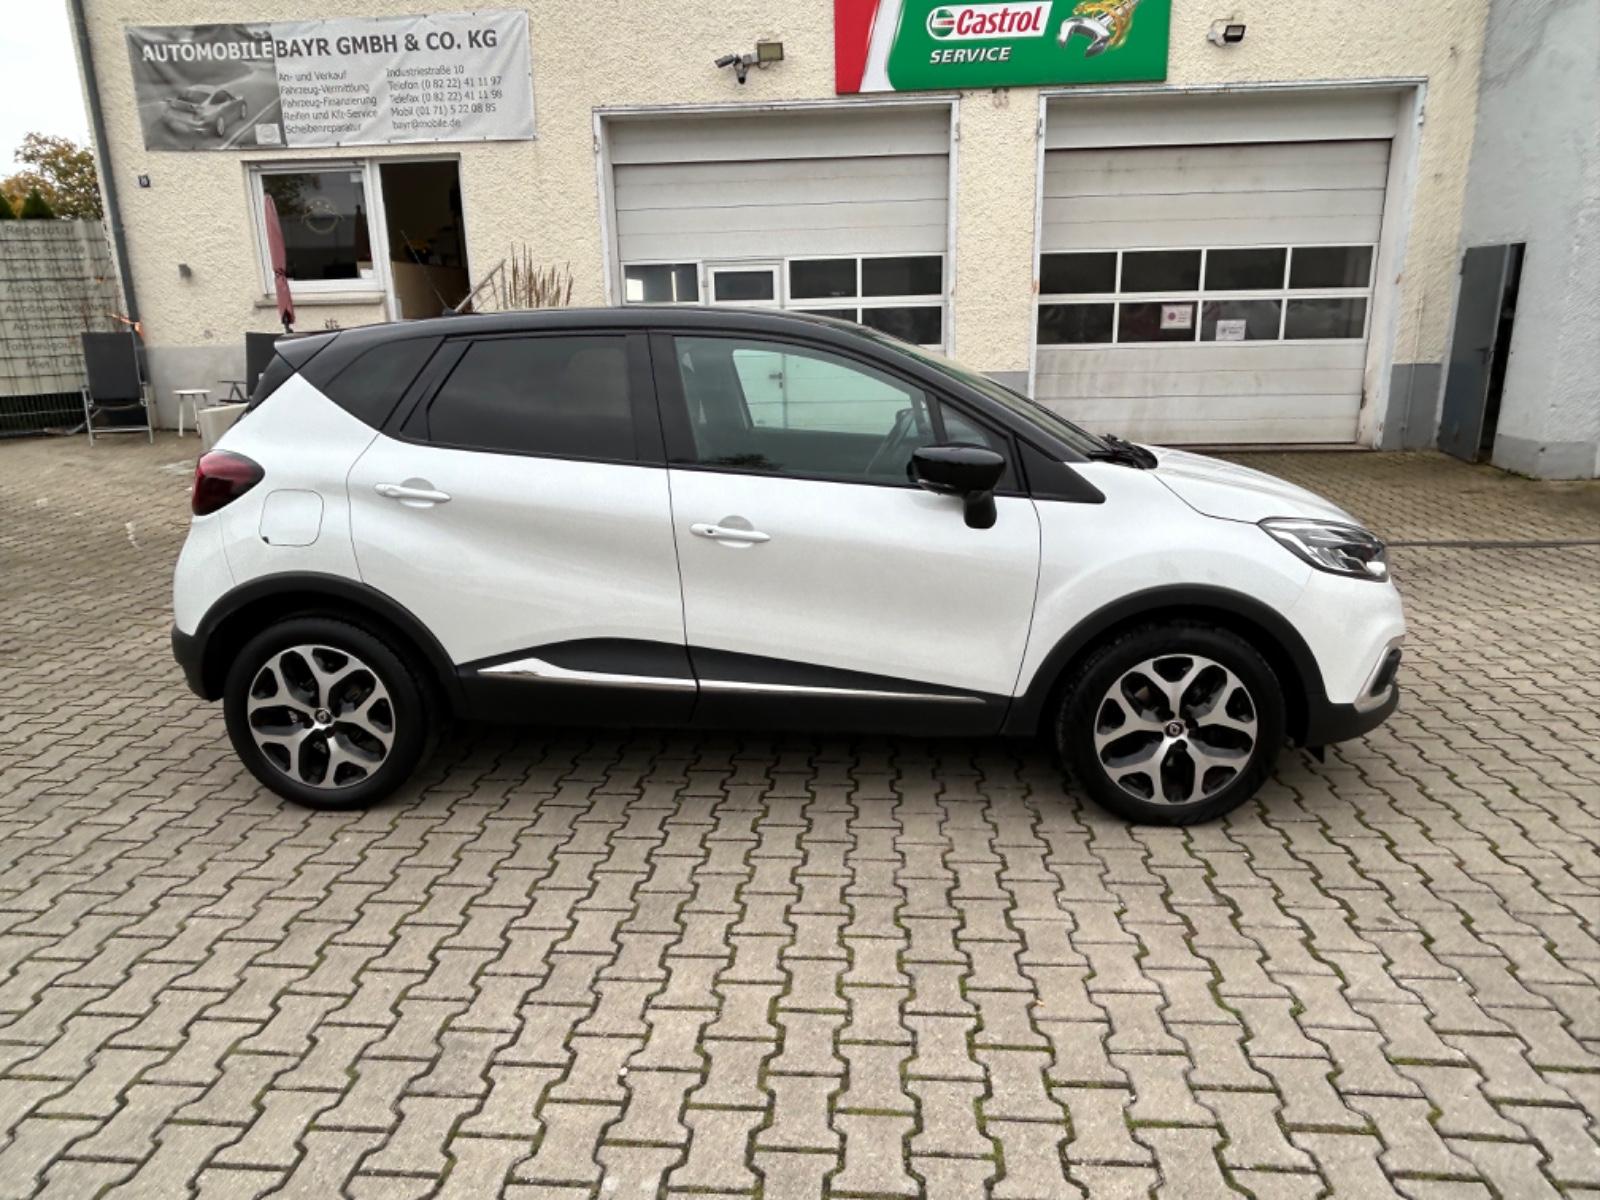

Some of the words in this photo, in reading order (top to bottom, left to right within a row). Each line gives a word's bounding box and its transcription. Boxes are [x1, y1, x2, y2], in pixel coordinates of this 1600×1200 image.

[956, 6, 1043, 35] Castrol
[275, 38, 332, 58] BAYR
[336, 34, 398, 55] GMBH
[404, 33, 420, 51] &
[426, 31, 461, 50] CO.
[468, 29, 497, 48] KG
[929, 47, 1012, 64] SERVICE
[296, 72, 311, 81] und
[314, 69, 347, 80] Verkauf
[386, 65, 451, 77] Industriestraße
[454, 64, 464, 74] 10
[387, 80, 418, 91] Telefon
[447, 78, 461, 89] 22)
[463, 77, 474, 87] 41
[478, 77, 488, 87] 11
[389, 93, 419, 104] Telefax
[447, 91, 462, 102] 22)
[479, 90, 488, 100] 11
[283, 111, 310, 120] Reifen
[312, 110, 329, 120] und
[391, 106, 413, 117] Mobil
